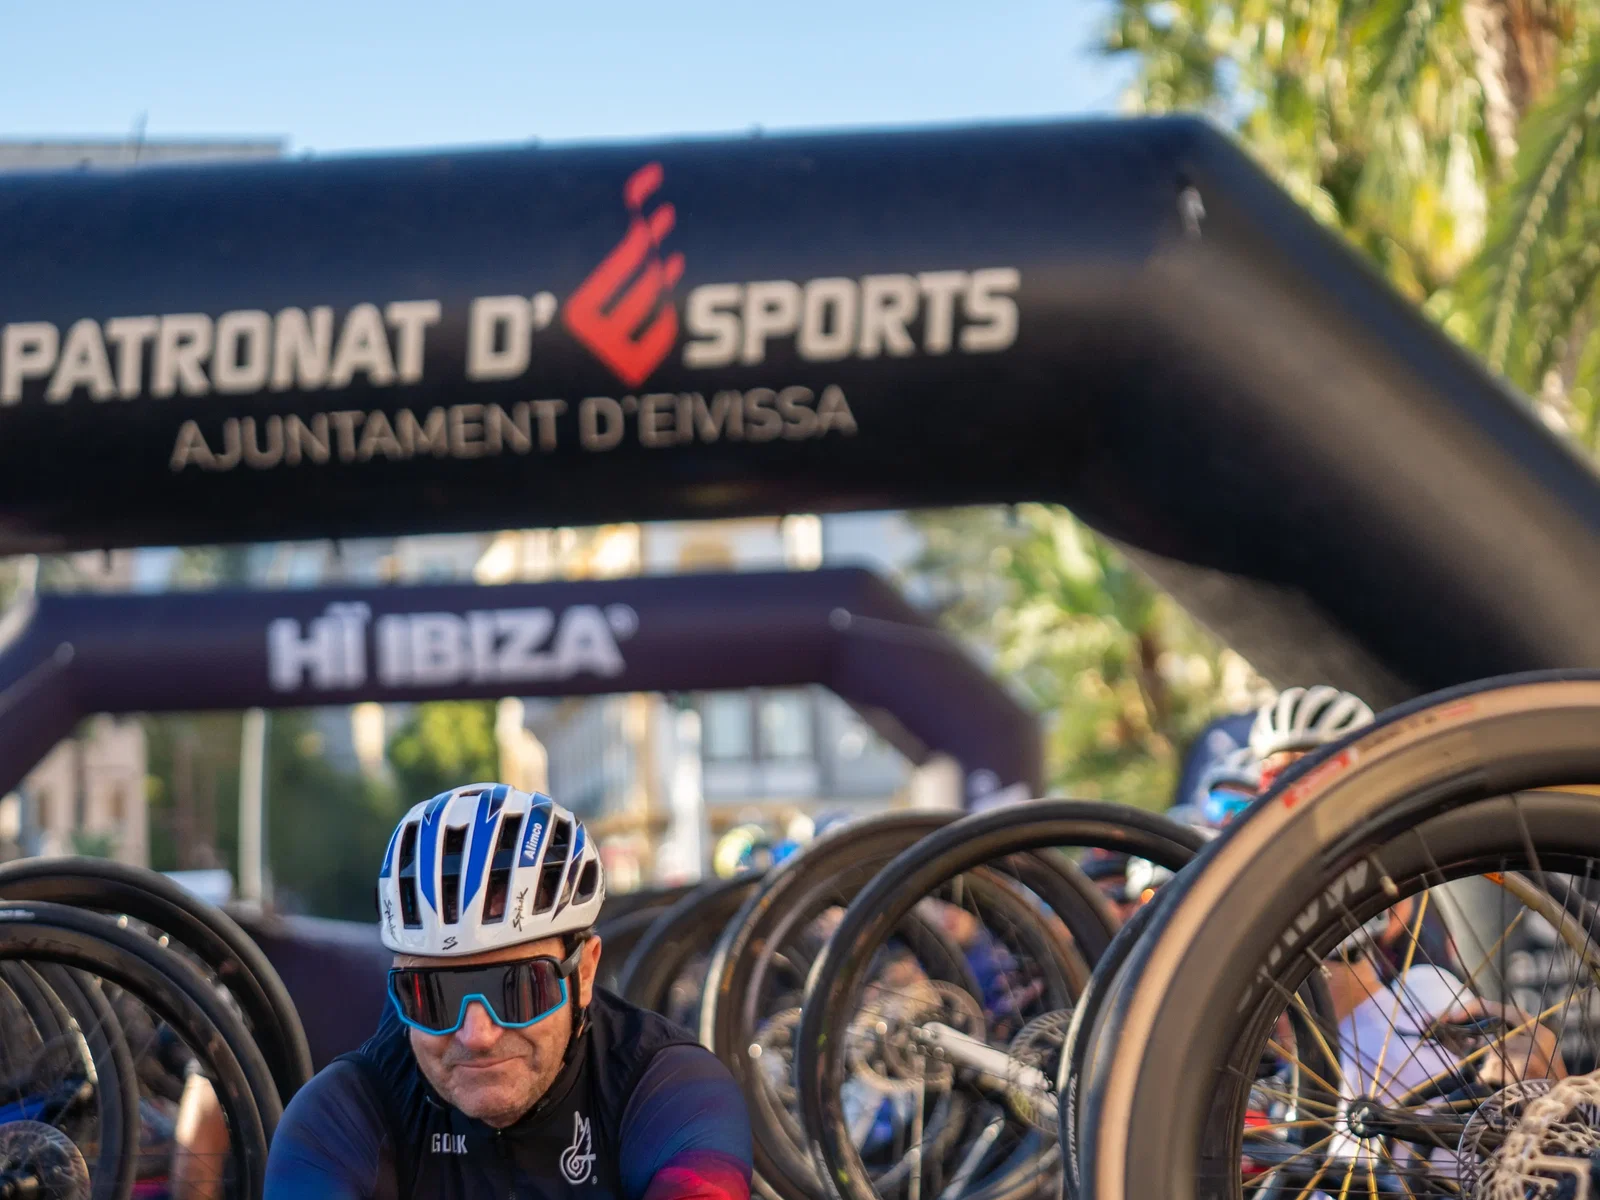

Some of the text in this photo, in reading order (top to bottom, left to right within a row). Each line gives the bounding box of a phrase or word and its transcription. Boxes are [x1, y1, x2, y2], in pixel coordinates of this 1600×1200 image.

[0, 299, 441, 405] PATRONAT
[169, 384, 858, 471] AJUNTAMENT D'EIVISSA
[375, 604, 626, 687] IBIZA
[523, 822, 543, 860] Alimco
